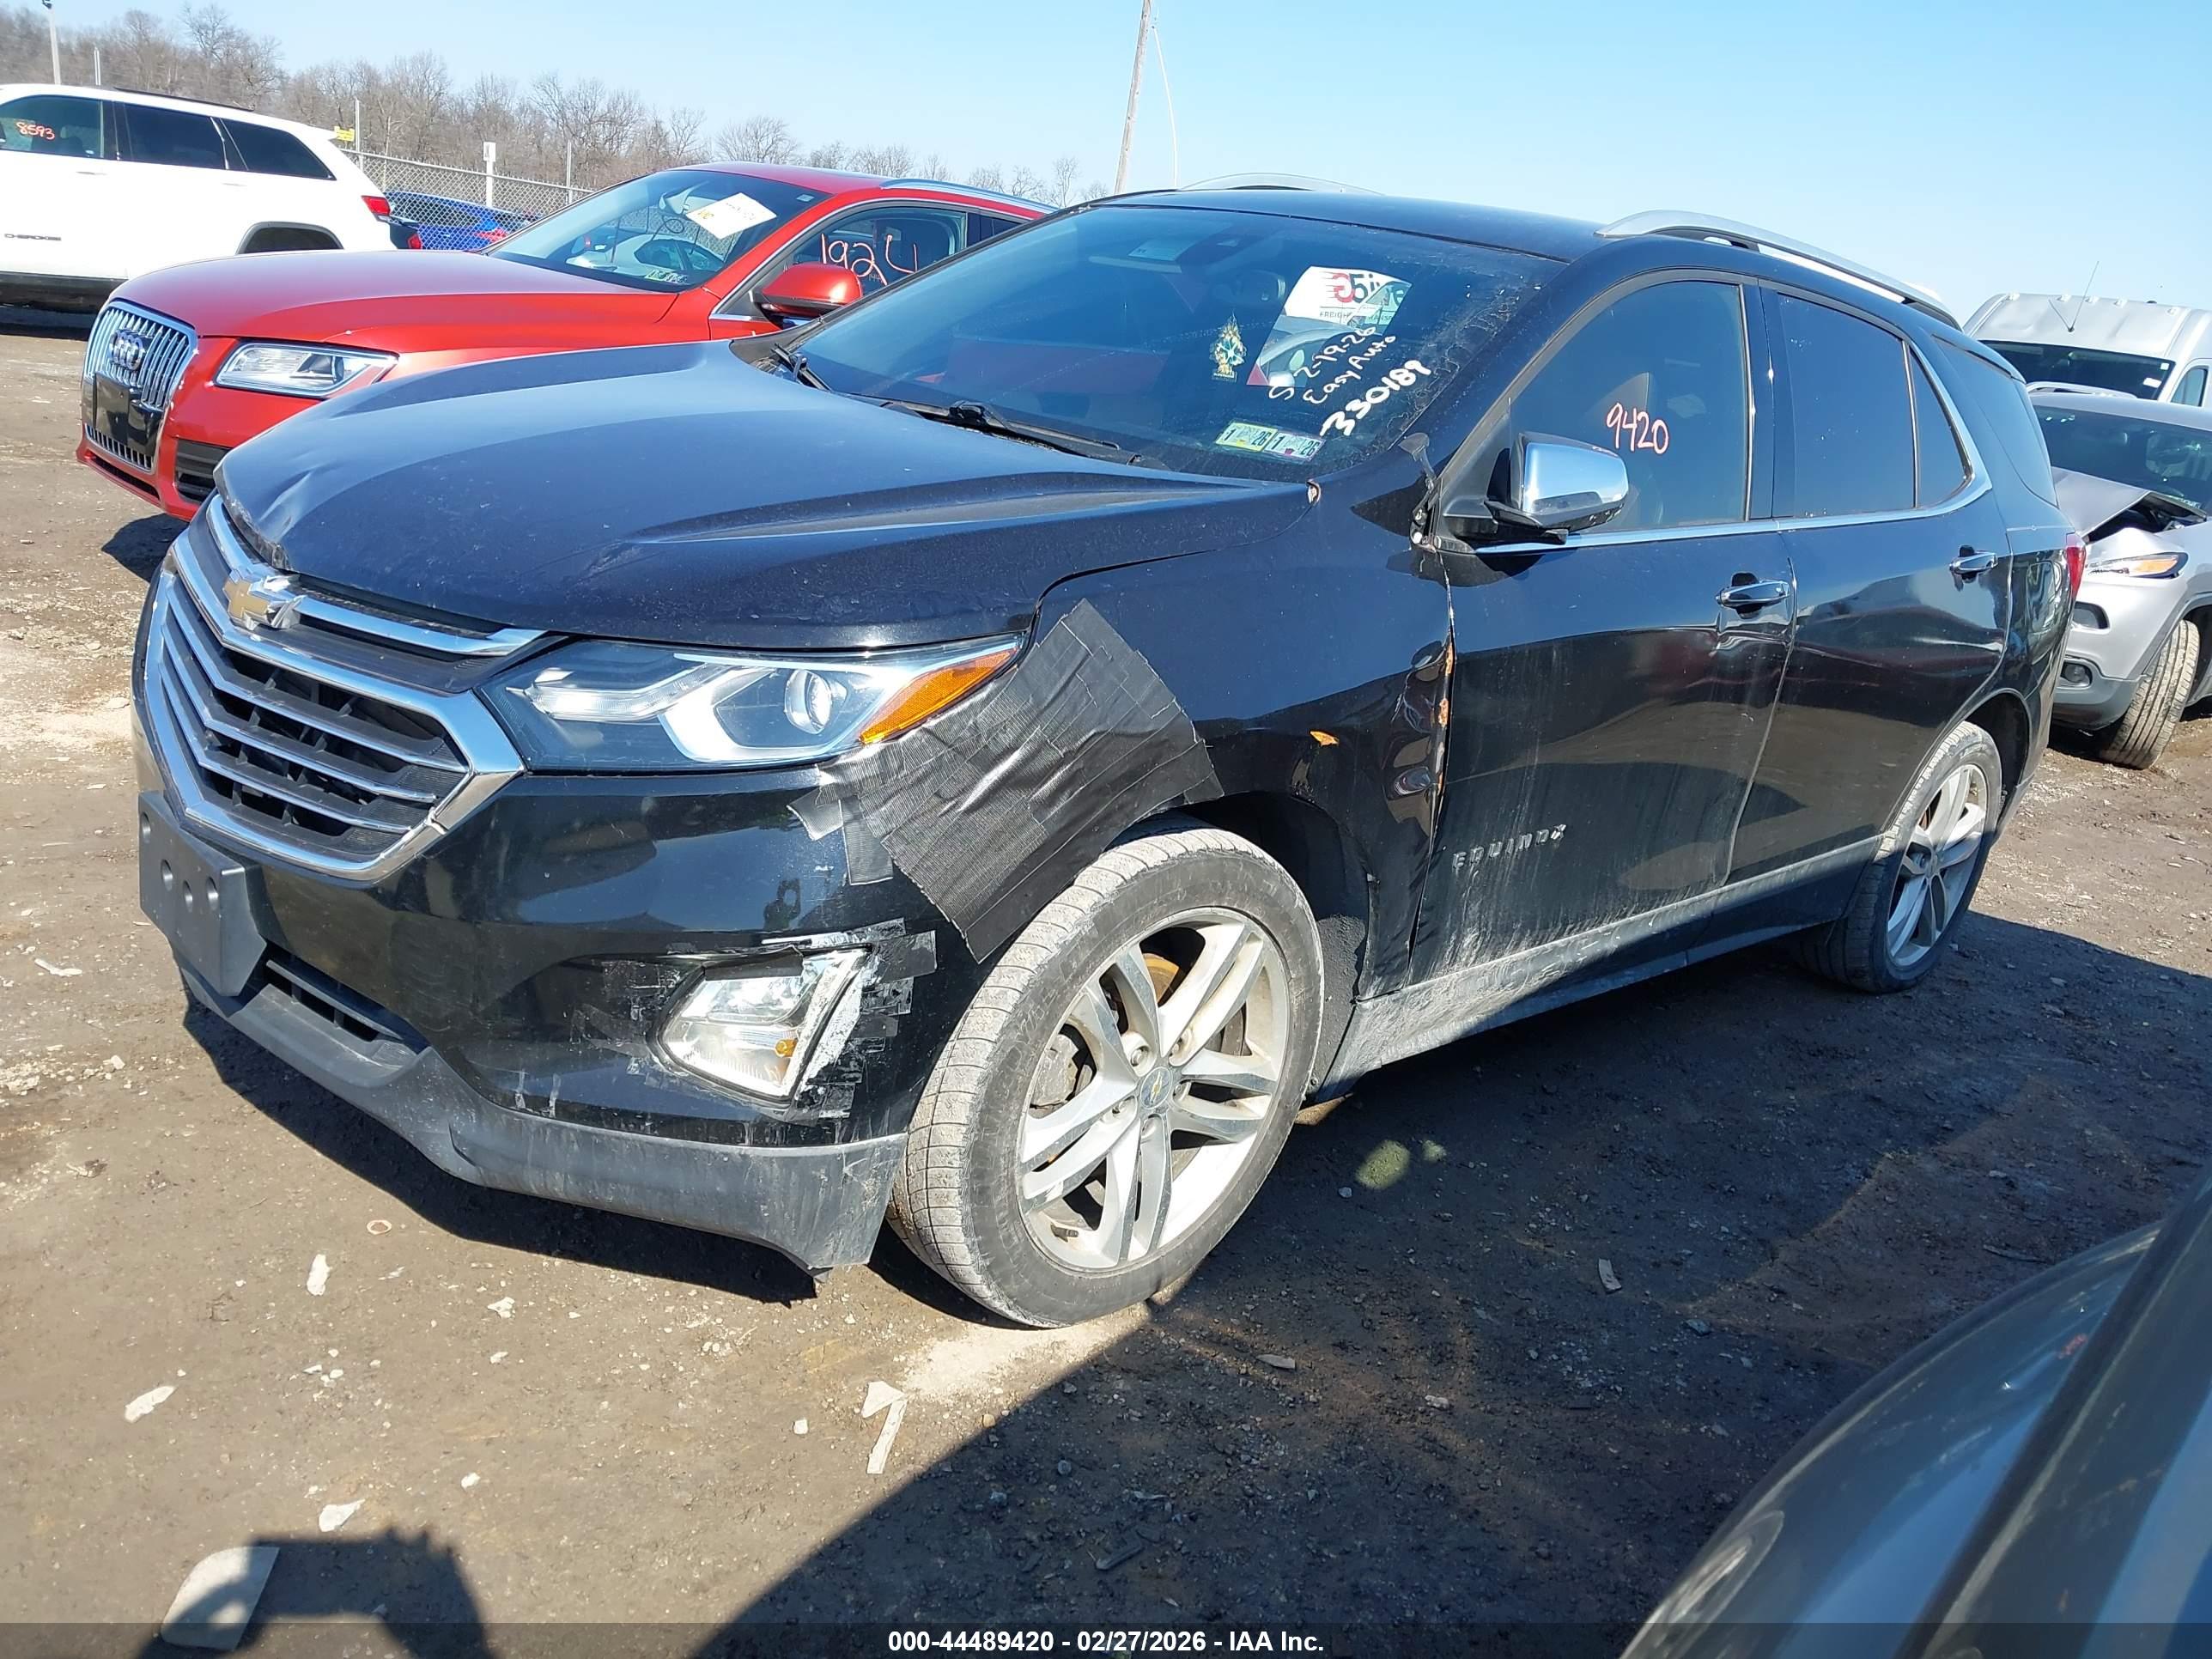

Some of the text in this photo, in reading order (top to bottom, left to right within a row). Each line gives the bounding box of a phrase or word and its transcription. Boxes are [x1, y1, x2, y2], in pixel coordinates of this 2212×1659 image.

[15, 121, 55, 140] 8593
[821, 234, 918, 286] 1924
[1606, 402, 1669, 454] 9420
